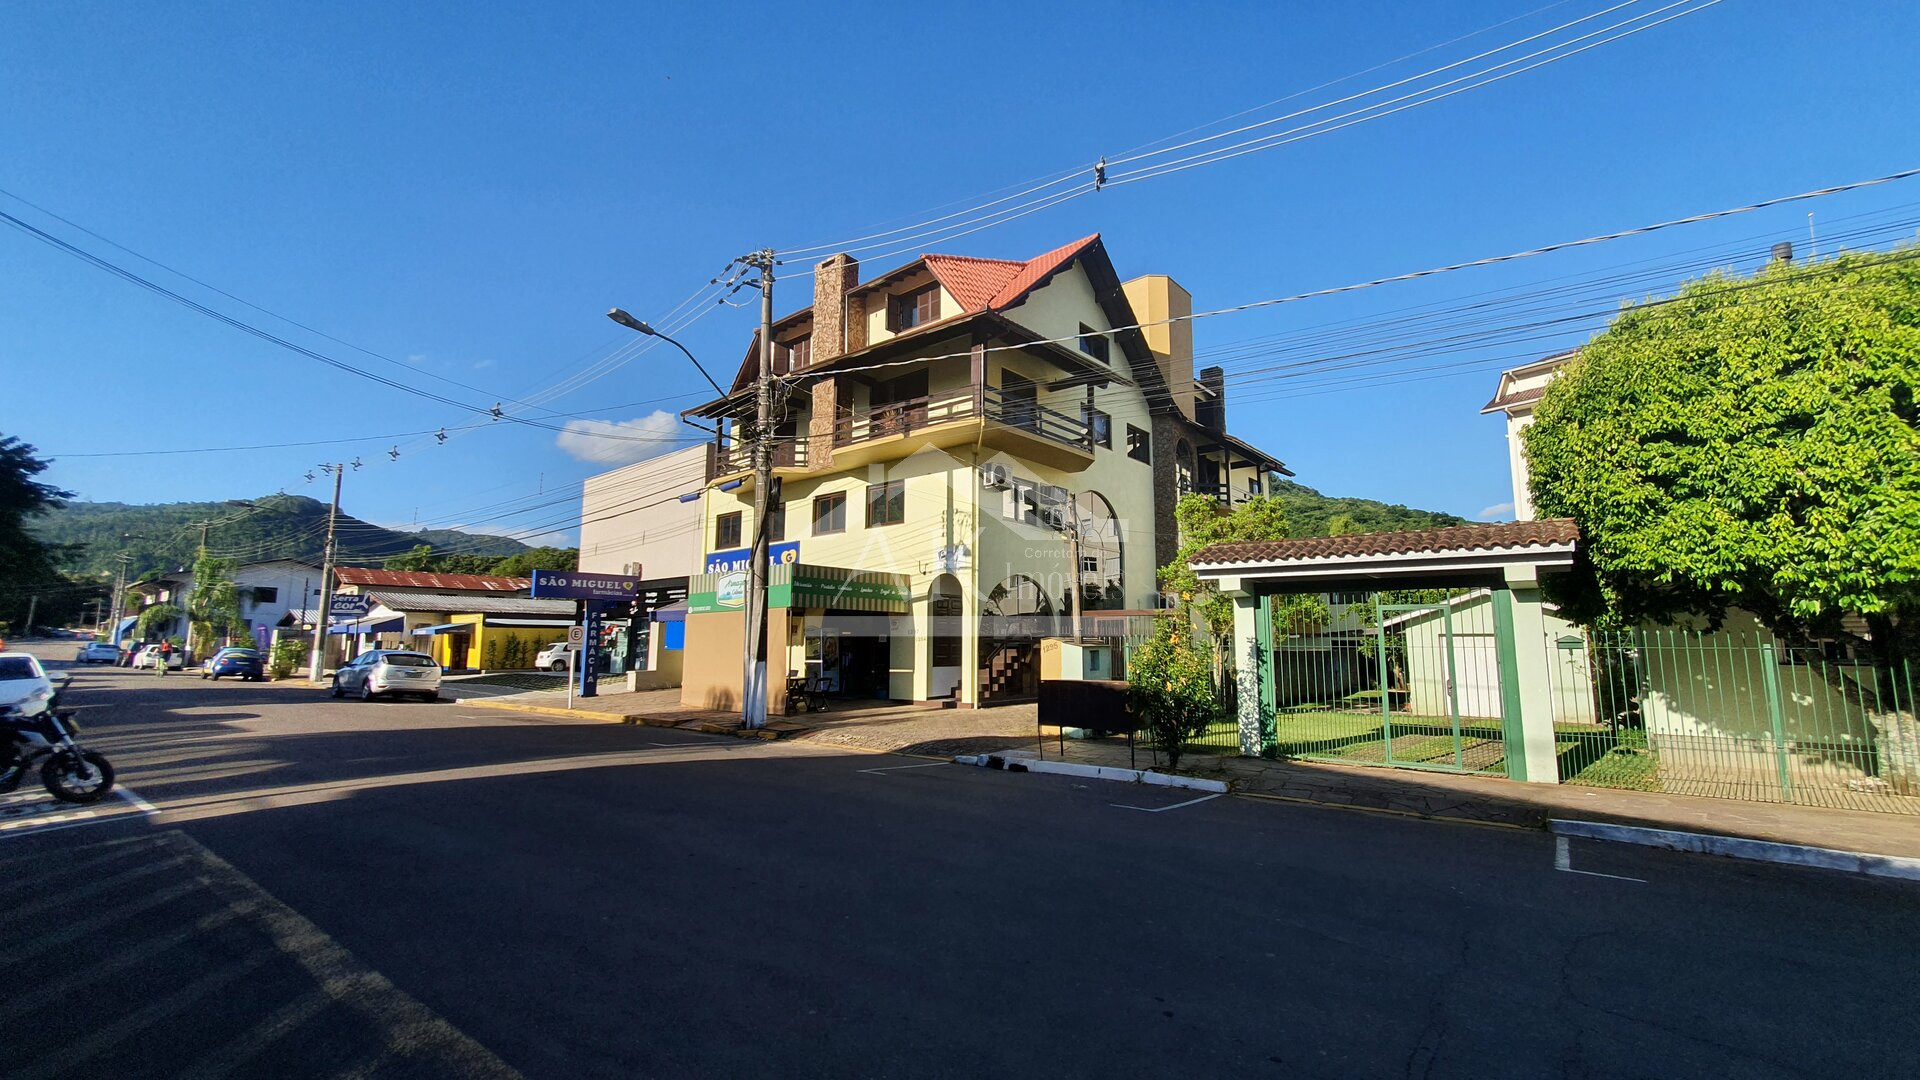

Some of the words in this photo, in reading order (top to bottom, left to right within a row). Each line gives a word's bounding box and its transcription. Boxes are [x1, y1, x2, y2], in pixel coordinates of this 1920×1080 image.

[708, 558, 728, 574] SÃO
[540, 576, 566, 587] SÃO
[572, 579, 621, 589] MIGUEL
